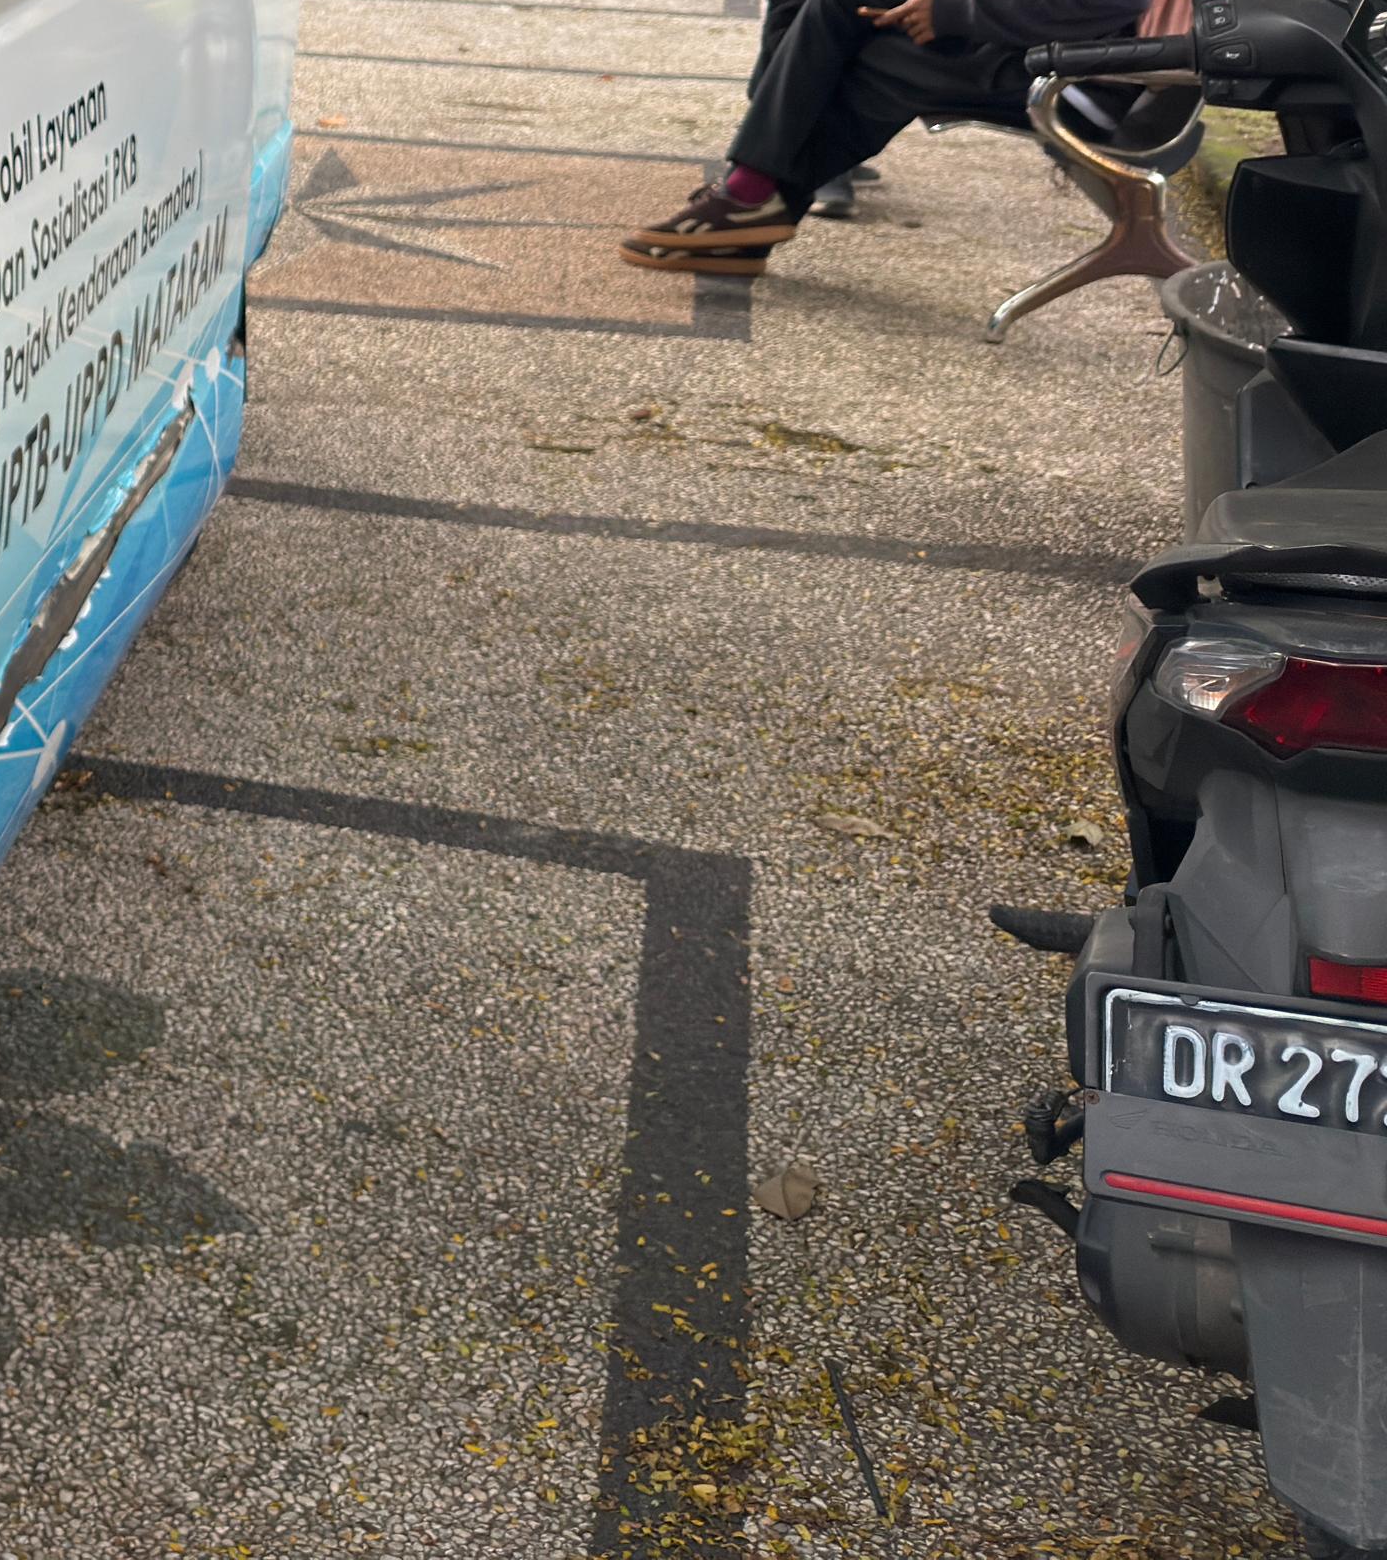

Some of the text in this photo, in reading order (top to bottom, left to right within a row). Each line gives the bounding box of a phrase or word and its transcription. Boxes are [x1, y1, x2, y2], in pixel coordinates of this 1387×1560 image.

[37, 81, 107, 172] Layanan
[30, 154, 109, 280] Sosialisasi
[112, 133, 138, 203] PKB
[1, 310, 51, 411] Pajak
[55, 227, 137, 350] Kendaraan
[141, 166, 197, 258] Bermotor
[126, 204, 229, 392] MATARAM
[1163, 1025, 1387, 1124] DR 27
